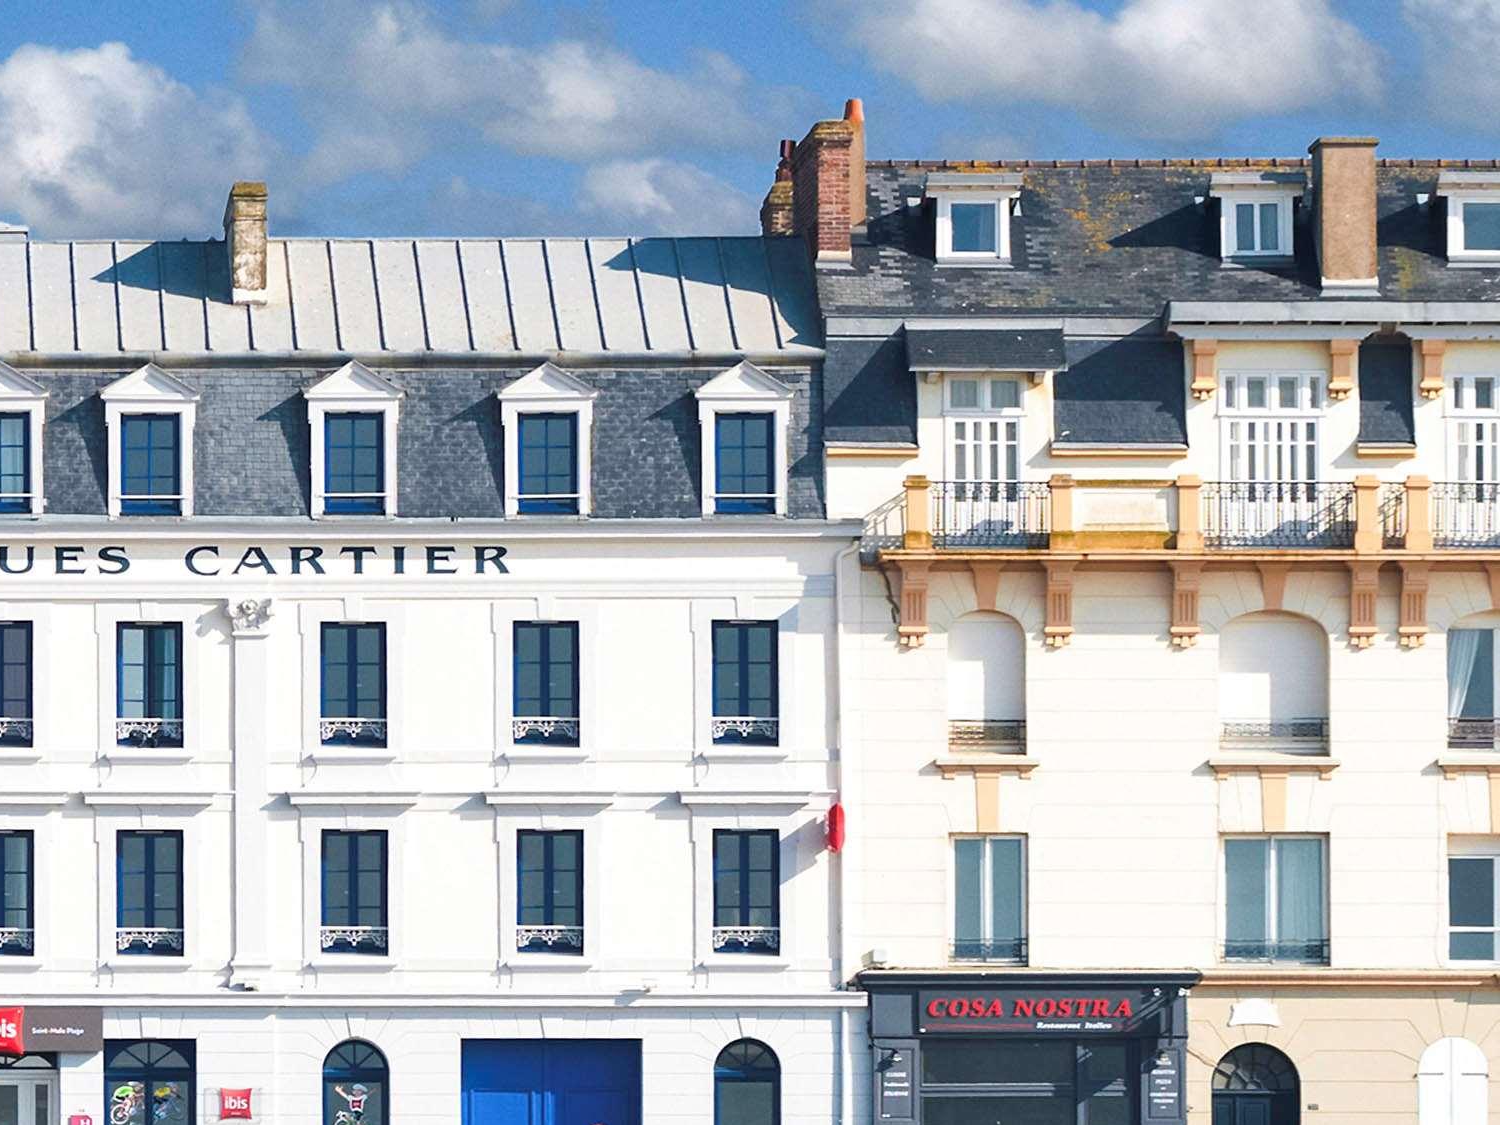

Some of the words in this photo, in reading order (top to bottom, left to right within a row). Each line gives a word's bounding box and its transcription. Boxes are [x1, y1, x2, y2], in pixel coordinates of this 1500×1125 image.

[184, 545, 510, 576] CARTIER
[927, 999, 1004, 1018] COSA
[1013, 999, 1134, 1018] NOSTRA
[224, 1095, 248, 1110] ibis
